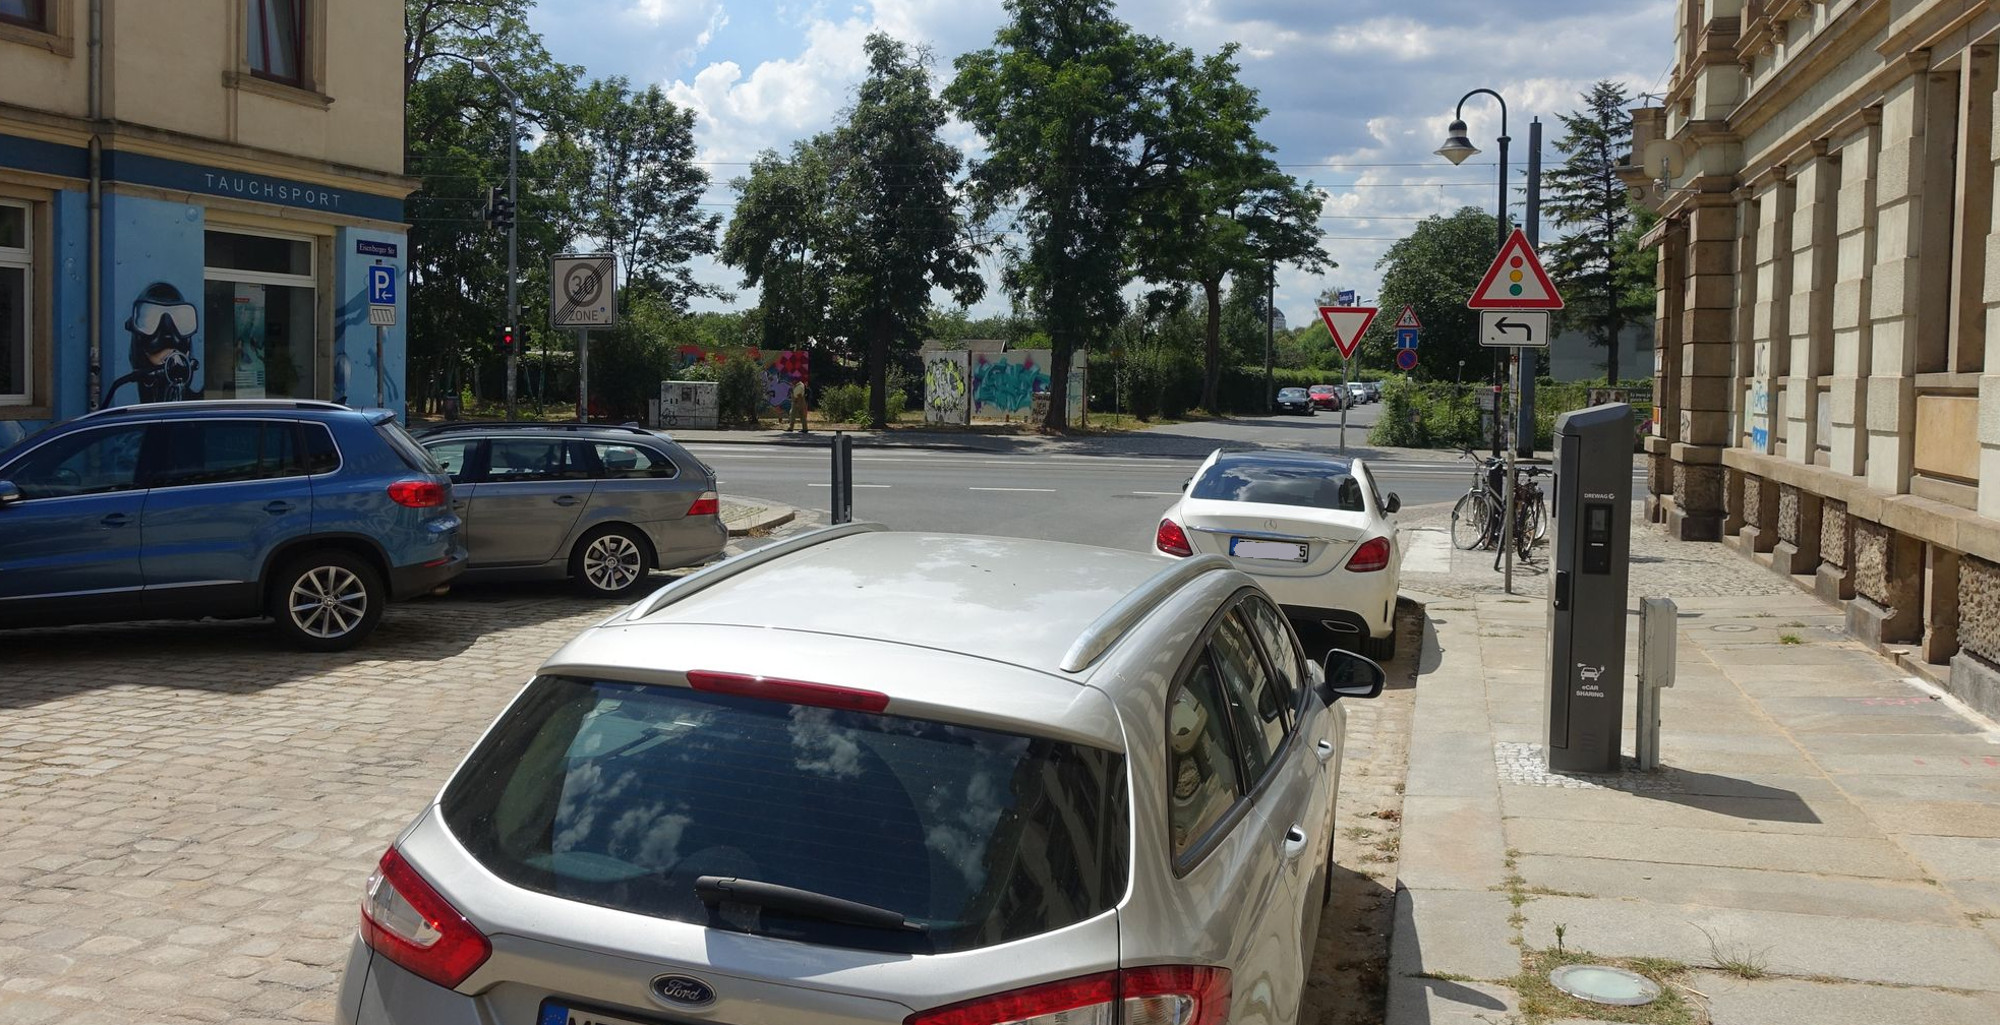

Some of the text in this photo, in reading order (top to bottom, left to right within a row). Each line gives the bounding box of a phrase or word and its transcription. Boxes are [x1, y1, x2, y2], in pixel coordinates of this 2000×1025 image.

[205, 173, 341, 206] TAUCHSPORT
[374, 270, 390, 300] P
[571, 275, 595, 295] 30
[568, 309, 599, 321] ZONE
[1576, 690, 1604, 698] SHARING
[663, 979, 702, 1001] Ford
